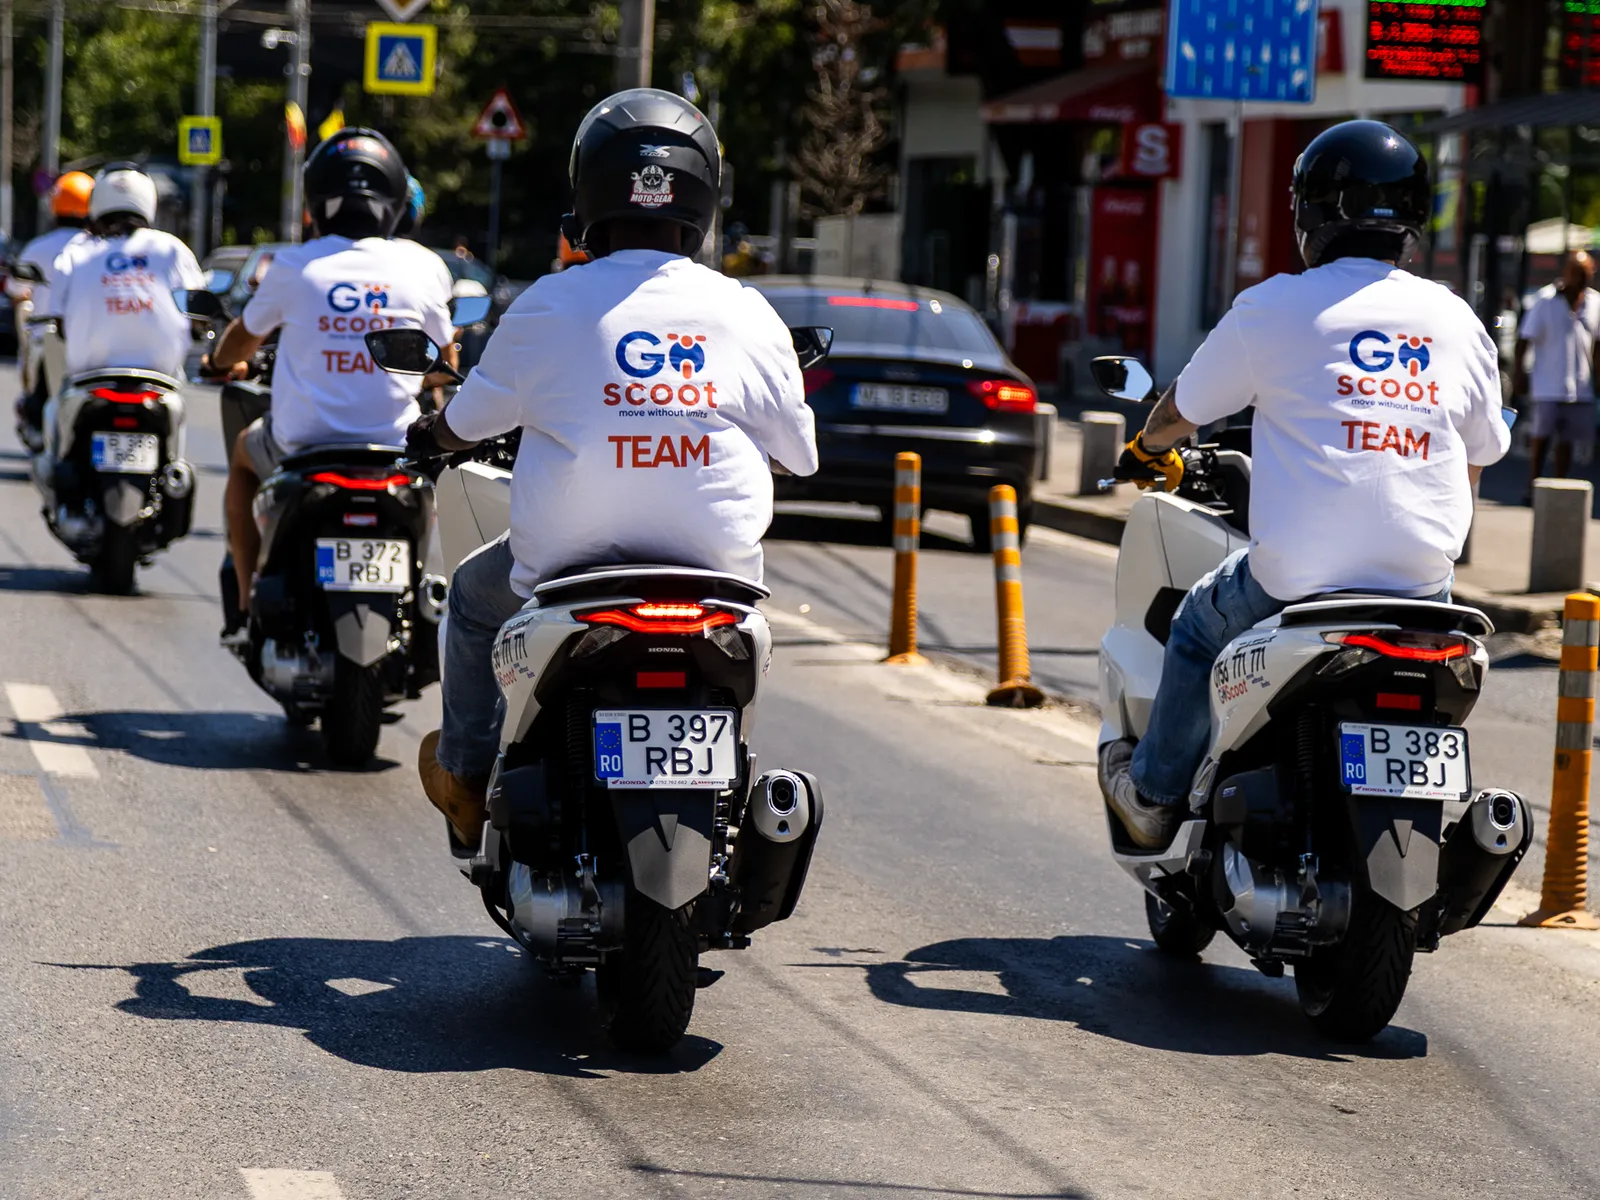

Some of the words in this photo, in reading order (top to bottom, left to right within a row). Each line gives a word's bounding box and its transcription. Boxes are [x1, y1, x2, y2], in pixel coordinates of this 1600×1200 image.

[630, 193, 673, 203] MOTO-GEAR
[603, 381, 717, 408] scoot
[1337, 375, 1439, 405] scoot
[619, 409, 645, 417] move
[647, 408, 683, 417] without
[686, 410, 708, 418] limits
[1378, 400, 1409, 410] without
[1410, 404, 1431, 414] limits
[608, 435, 710, 468] TEAM
[1341, 420, 1431, 460] TEAM
[336, 542, 350, 560] B
[362, 542, 401, 563] 372
[349, 563, 394, 582] RBJ
[628, 714, 651, 742] B
[667, 714, 728, 744] 397
[1370, 727, 1391, 754] B
[1405, 730, 1459, 760] 383
[600, 754, 621, 772] RO
[645, 747, 714, 775] RBJ
[1345, 762, 1365, 779] RO
[1386, 758, 1446, 787] RBJ
